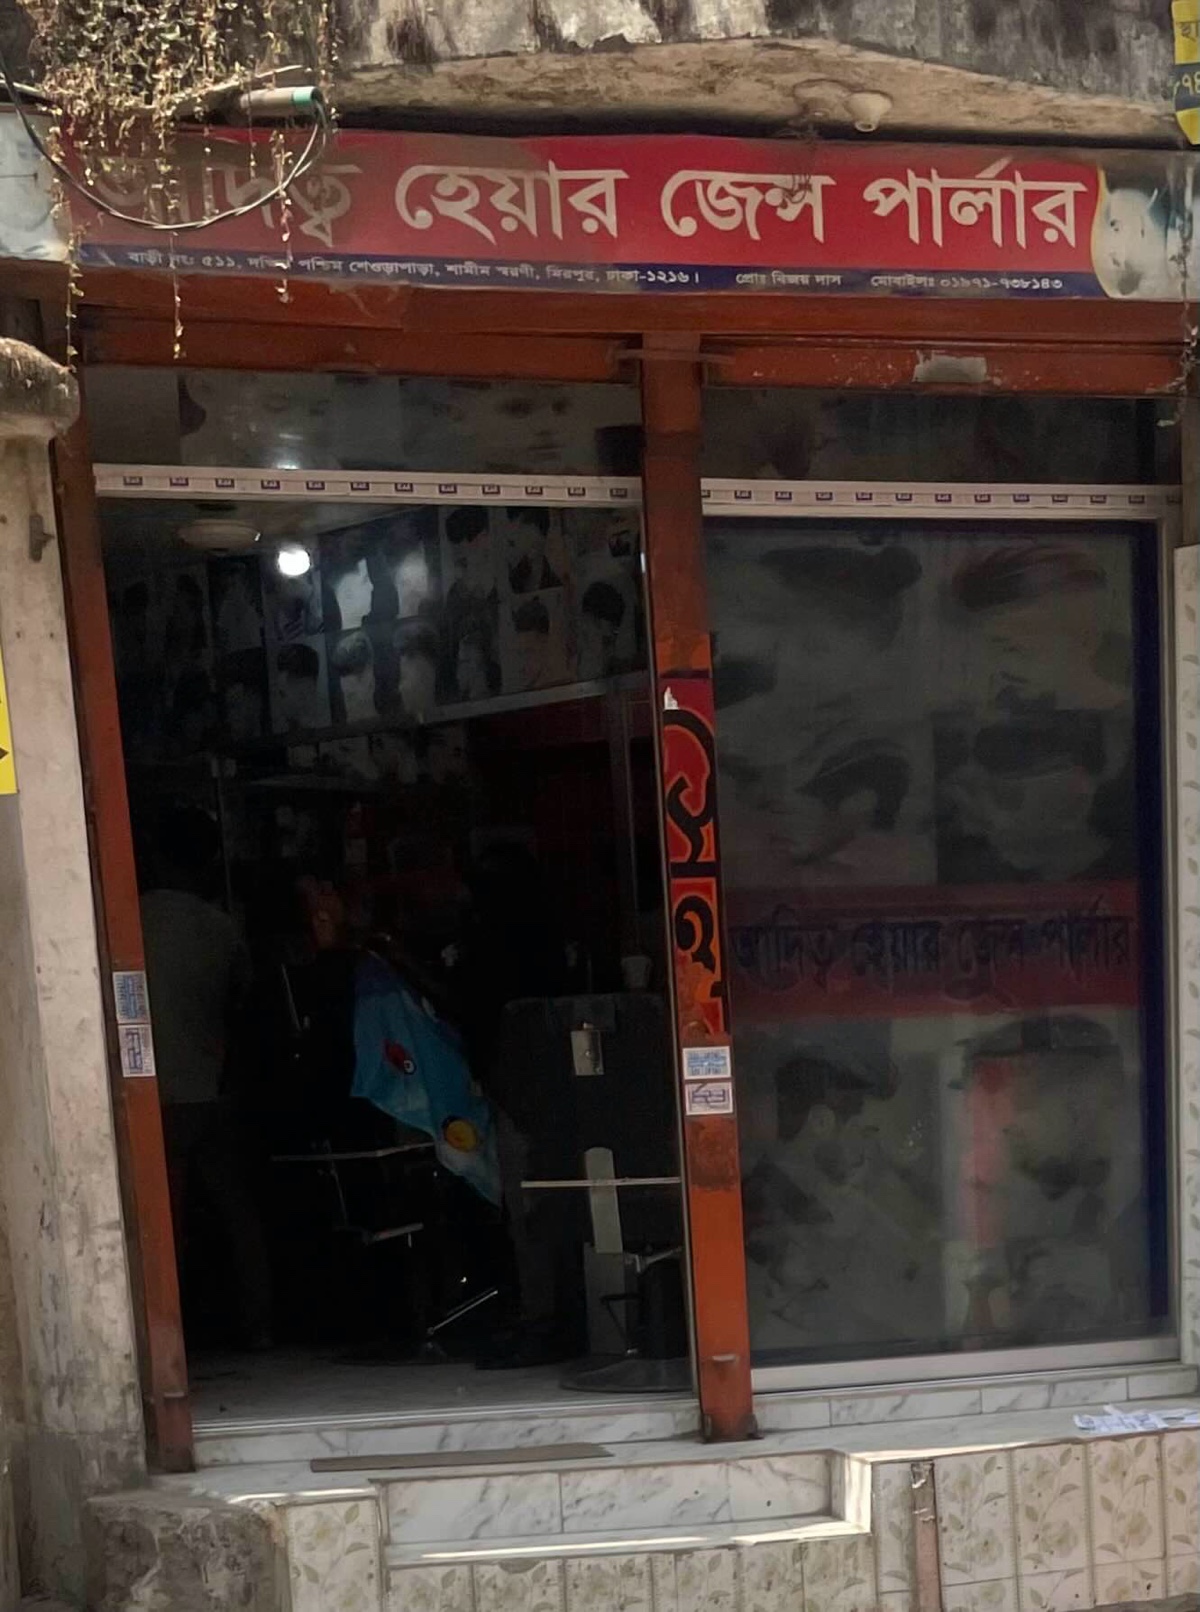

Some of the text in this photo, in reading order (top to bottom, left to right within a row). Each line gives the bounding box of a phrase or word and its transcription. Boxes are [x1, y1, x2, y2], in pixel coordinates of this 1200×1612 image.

[395, 160, 630, 246] হেয়ার
[660, 169, 837, 244] জেন্স
[862, 154, 1088, 250] পার্লার
